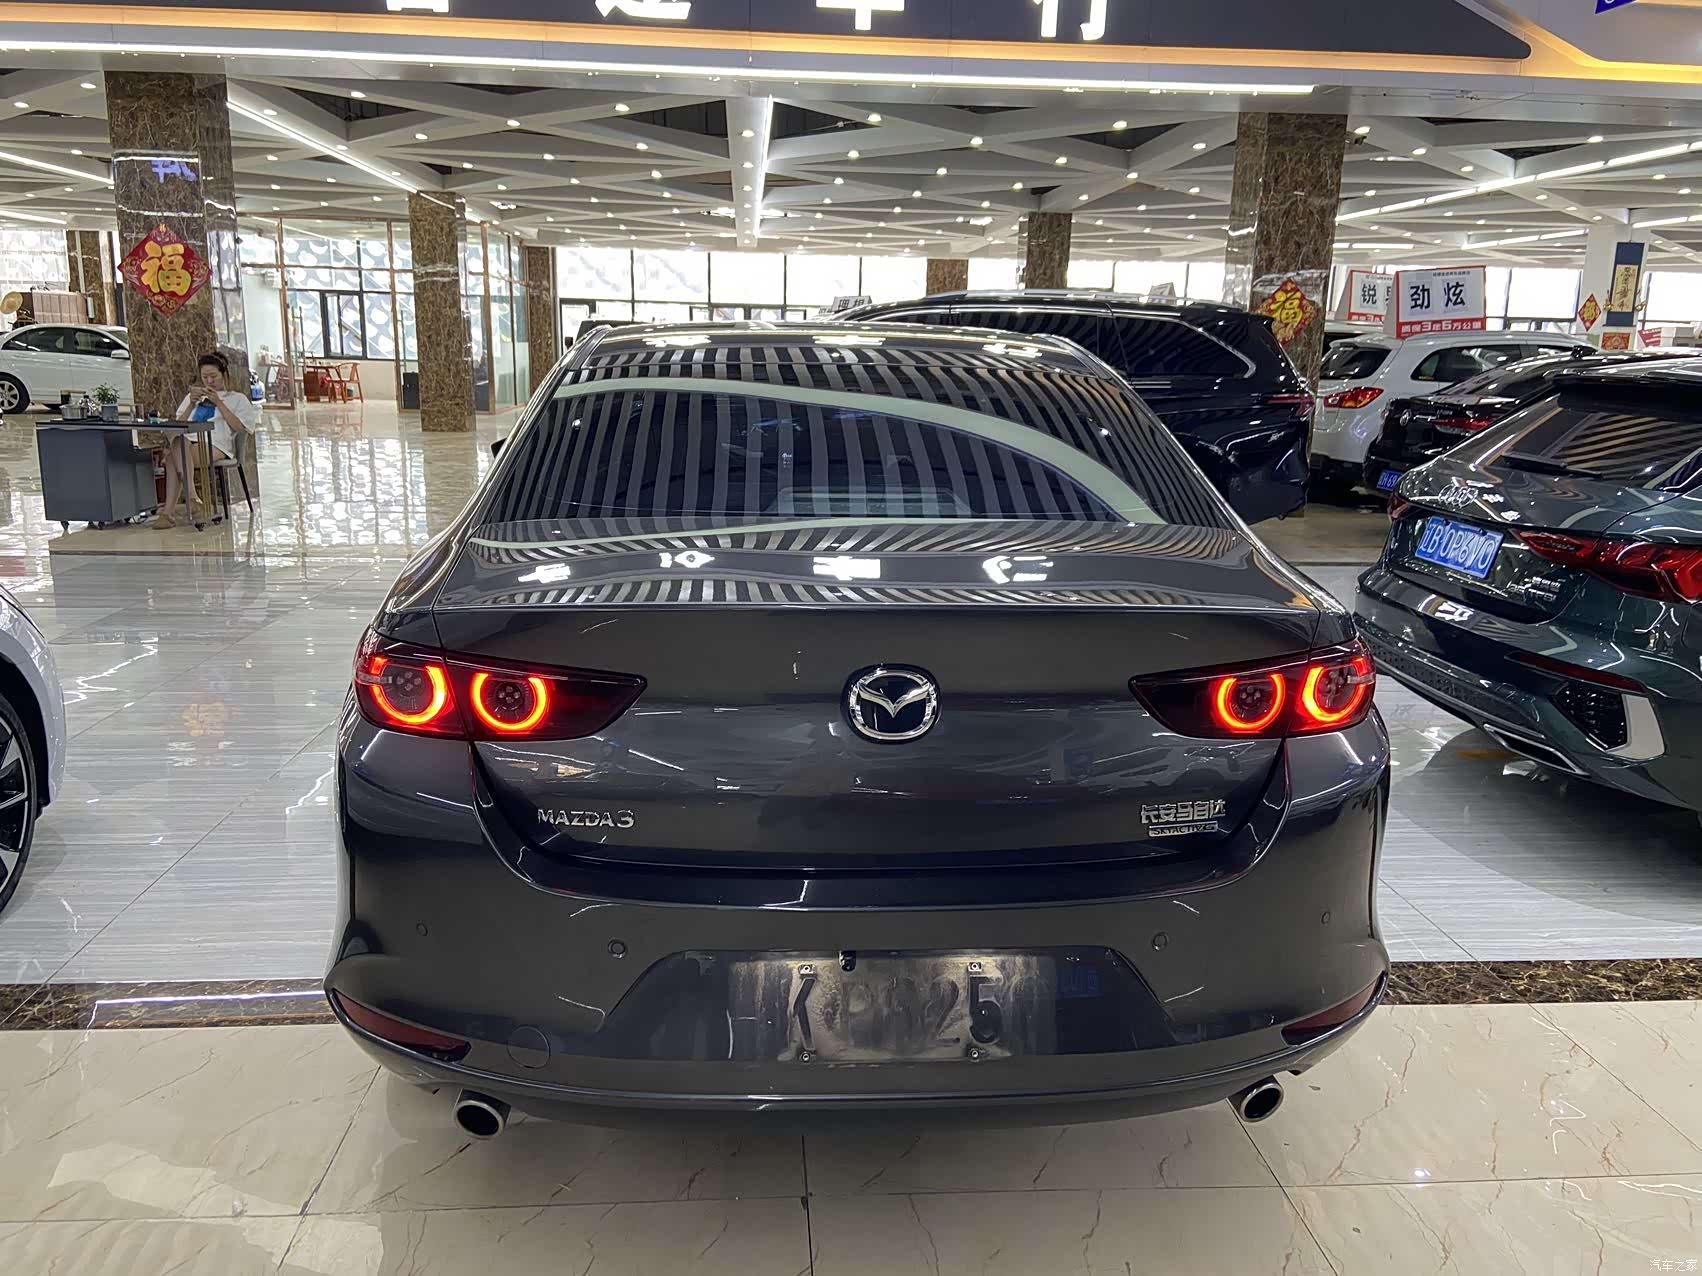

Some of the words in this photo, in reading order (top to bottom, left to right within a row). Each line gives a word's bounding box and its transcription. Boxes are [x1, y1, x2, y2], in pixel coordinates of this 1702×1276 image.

[141, 241, 192, 297] 福
[1270, 290, 1303, 328] 福
[1409, 281, 1466, 311] 劲炫
[1141, 799, 1226, 823] 长安马自达
